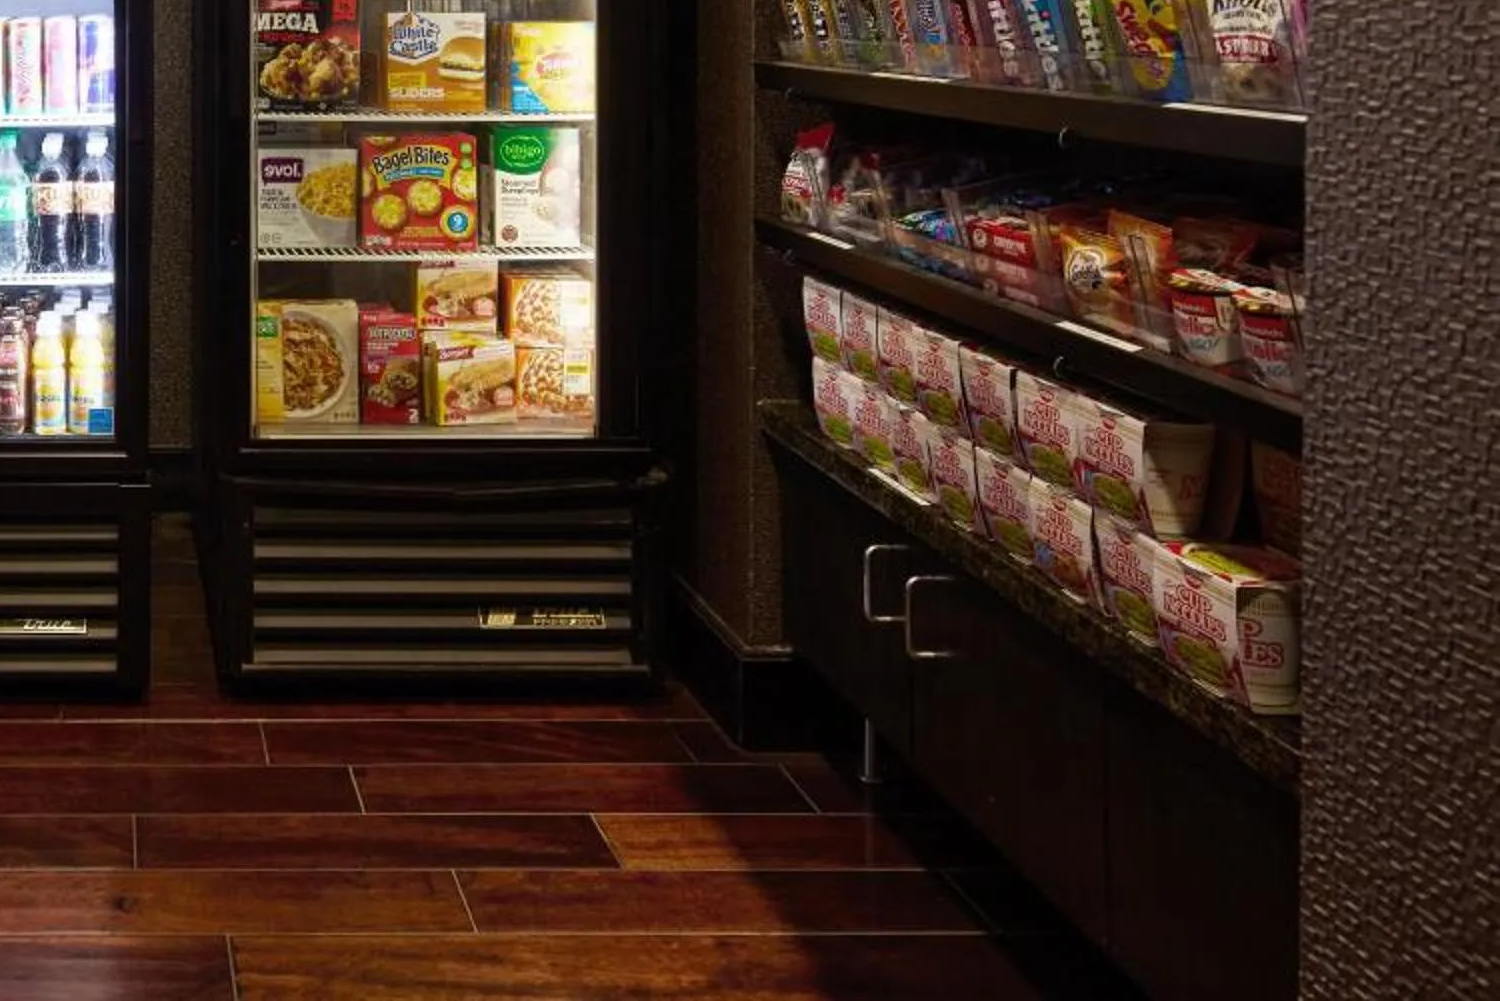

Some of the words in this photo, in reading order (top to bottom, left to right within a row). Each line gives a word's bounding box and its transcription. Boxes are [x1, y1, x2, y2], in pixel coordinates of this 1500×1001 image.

[256, 12, 320, 34] MEGA
[393, 25, 434, 40] White
[389, 39, 439, 55] Castle
[372, 147, 412, 174] Bagel
[413, 147, 450, 166] Bites
[1178, 584, 1213, 613] CUP
[1163, 591, 1227, 642] NOODLES
